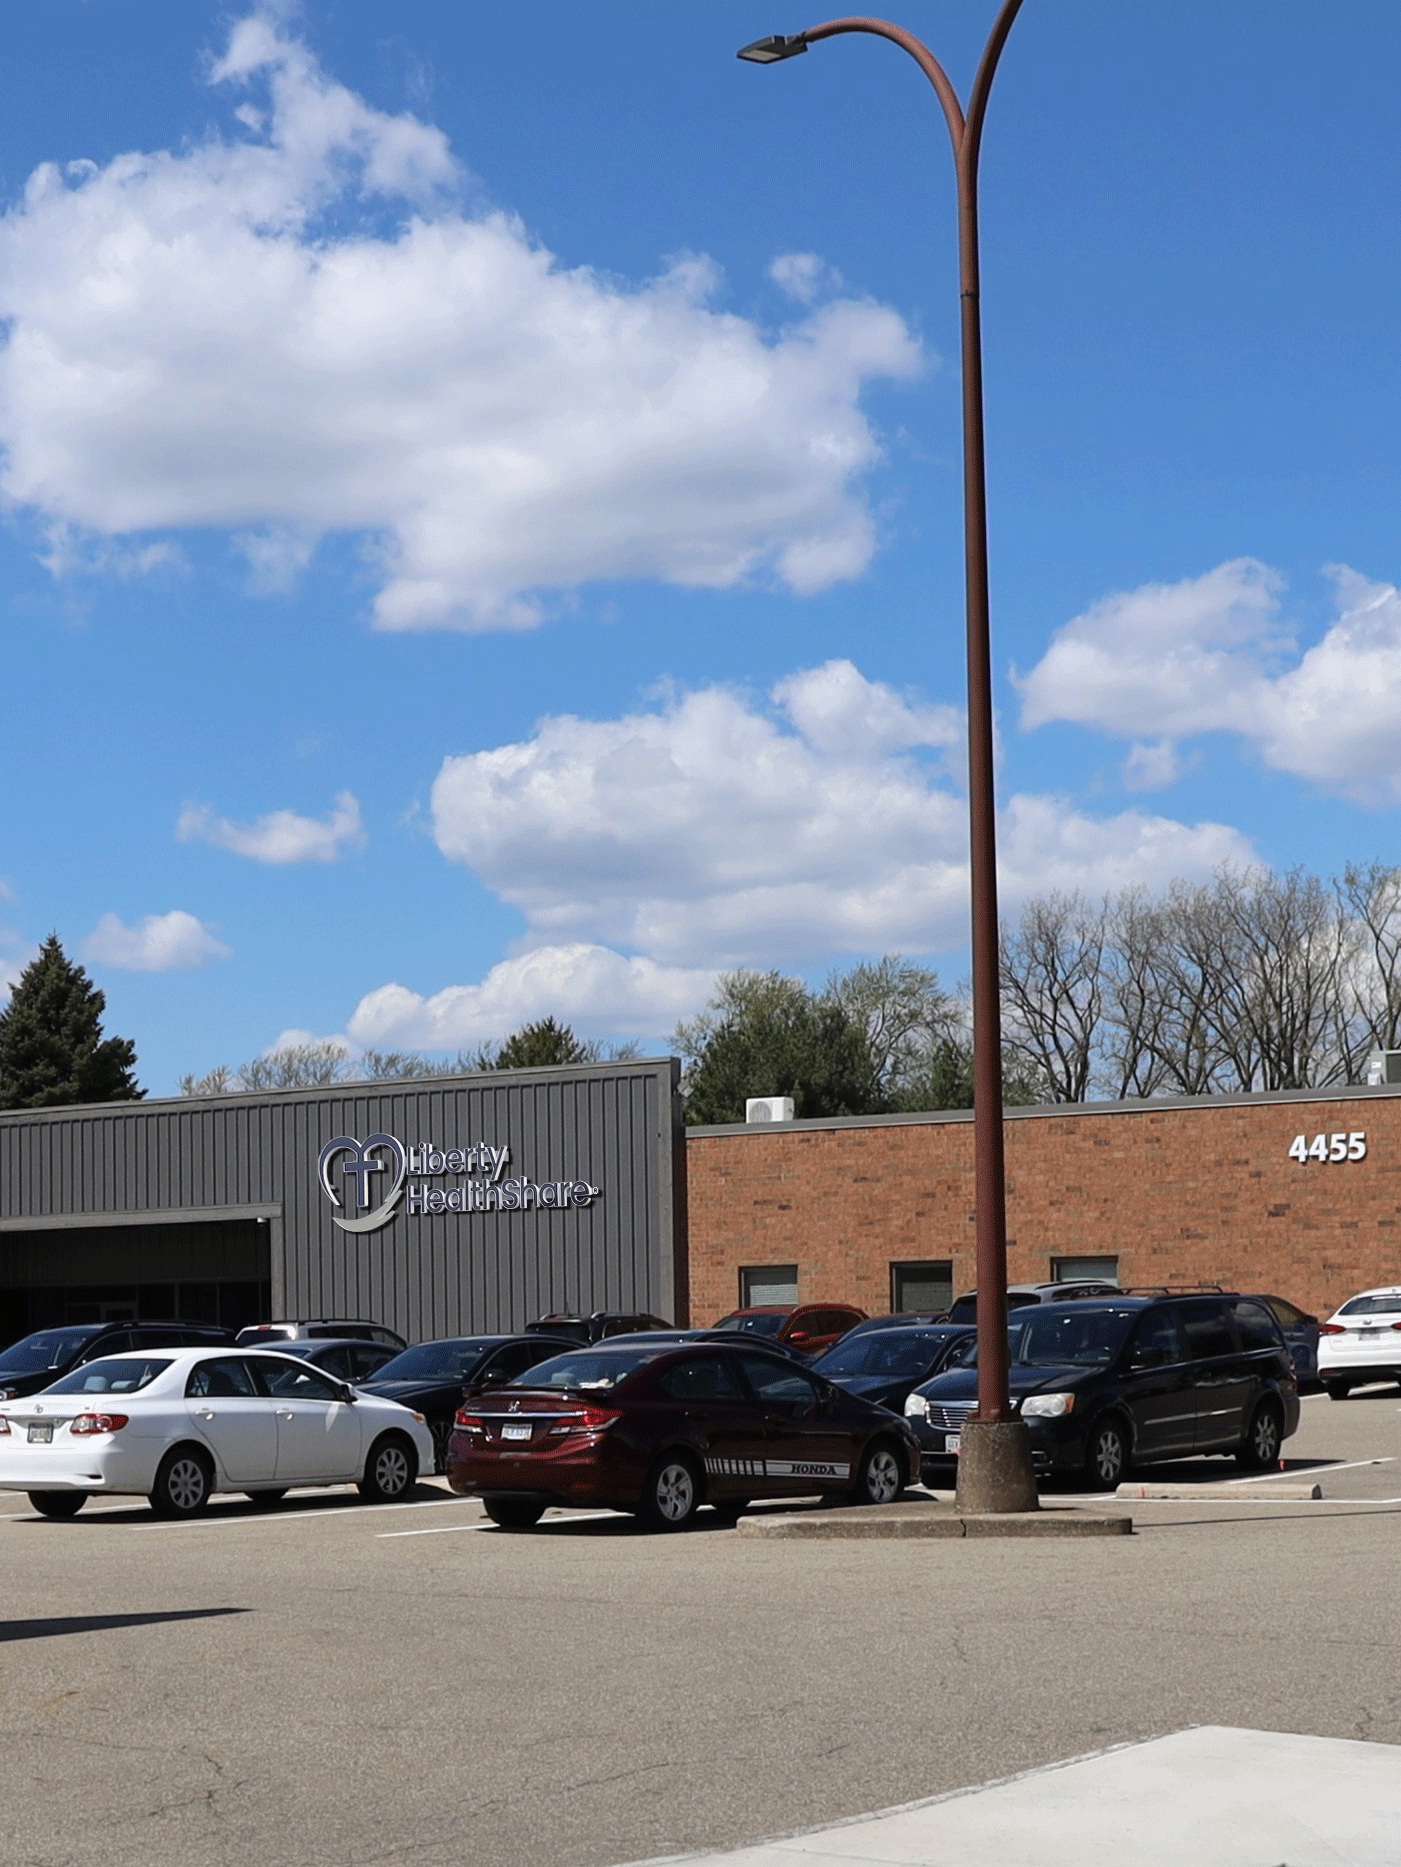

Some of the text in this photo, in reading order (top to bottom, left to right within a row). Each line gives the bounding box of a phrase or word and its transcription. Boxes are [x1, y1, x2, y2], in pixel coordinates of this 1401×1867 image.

[406, 1141, 508, 1181] Liberty
[1288, 1131, 1367, 1163] 4455
[791, 1463, 837, 1476] HONDA
